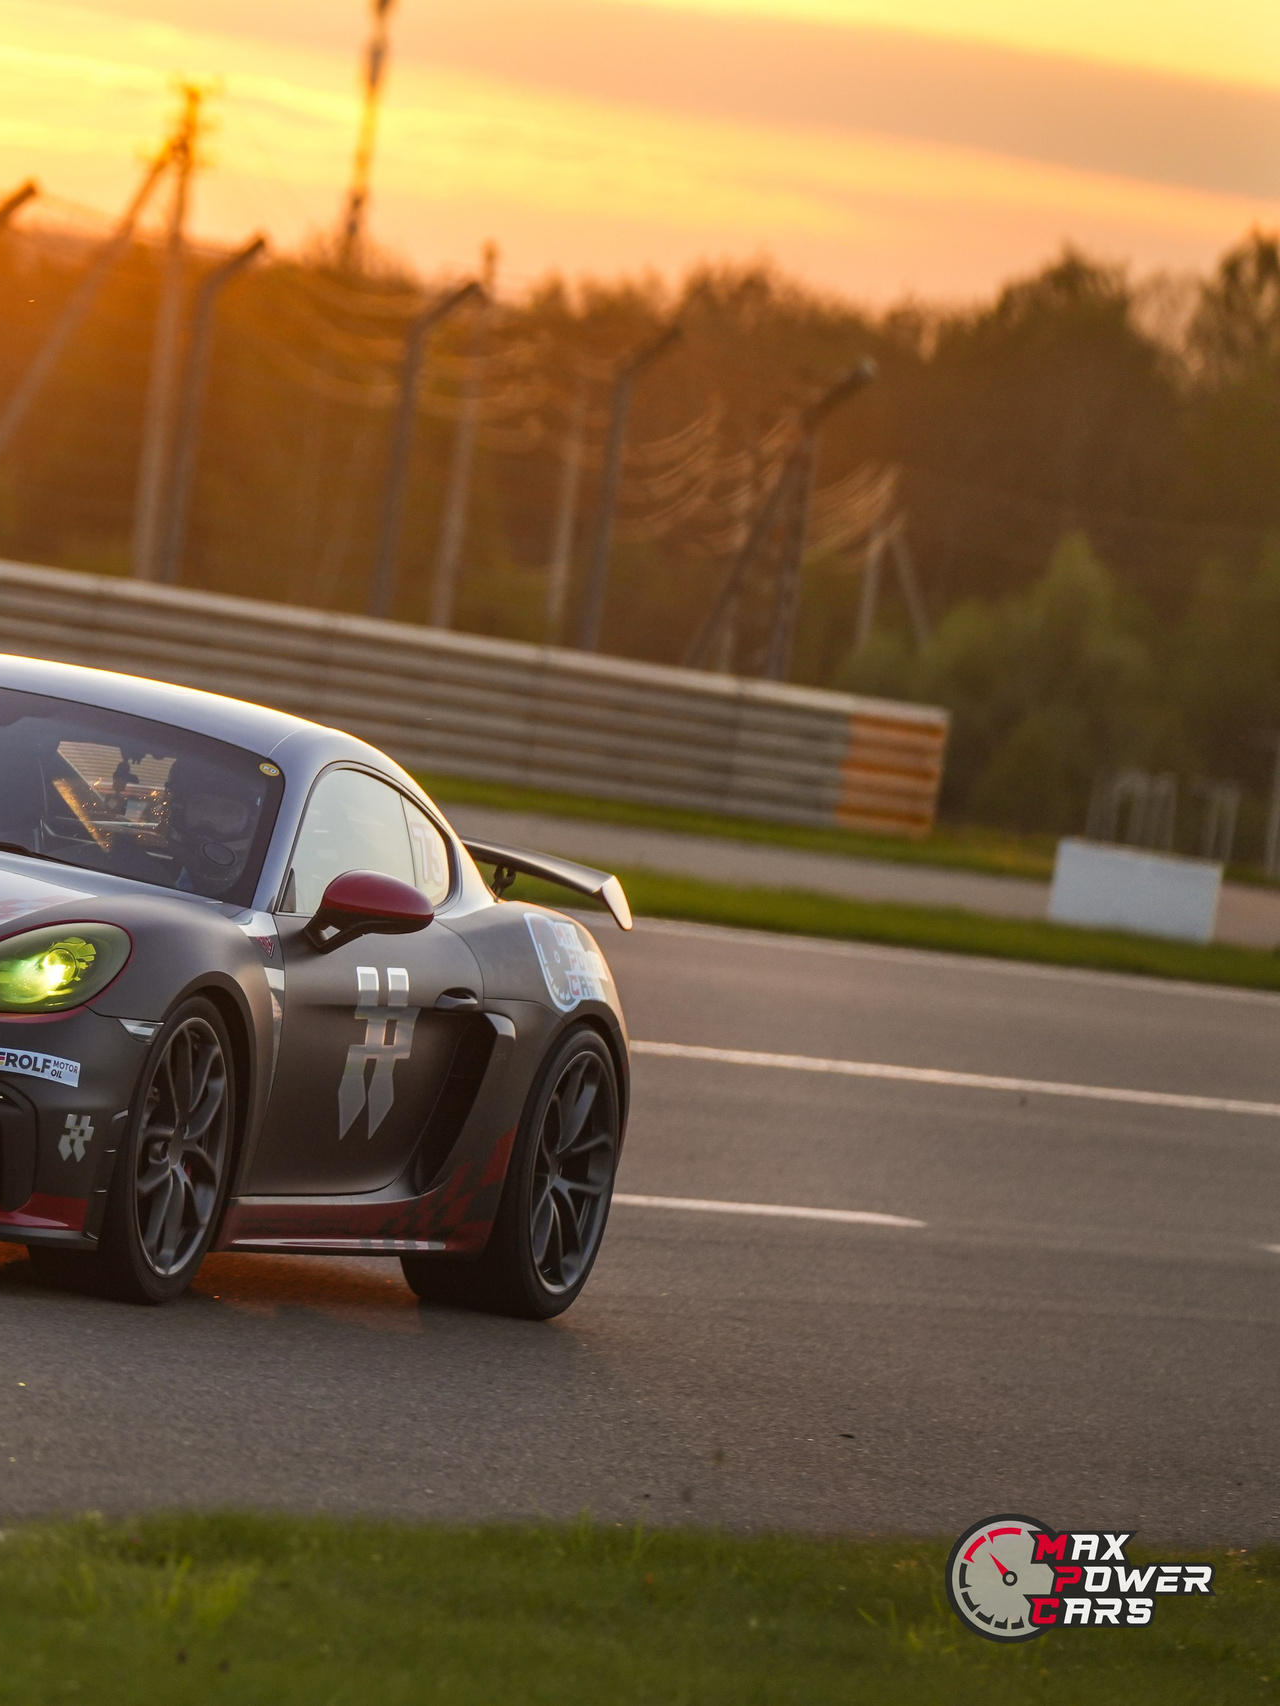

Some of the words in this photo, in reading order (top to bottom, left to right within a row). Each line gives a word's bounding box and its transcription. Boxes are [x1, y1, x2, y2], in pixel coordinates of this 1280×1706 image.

[4, 1052, 52, 1073] ROLF
[52, 1060, 79, 1074] MOTOR
[50, 1069, 63, 1079] OIL
